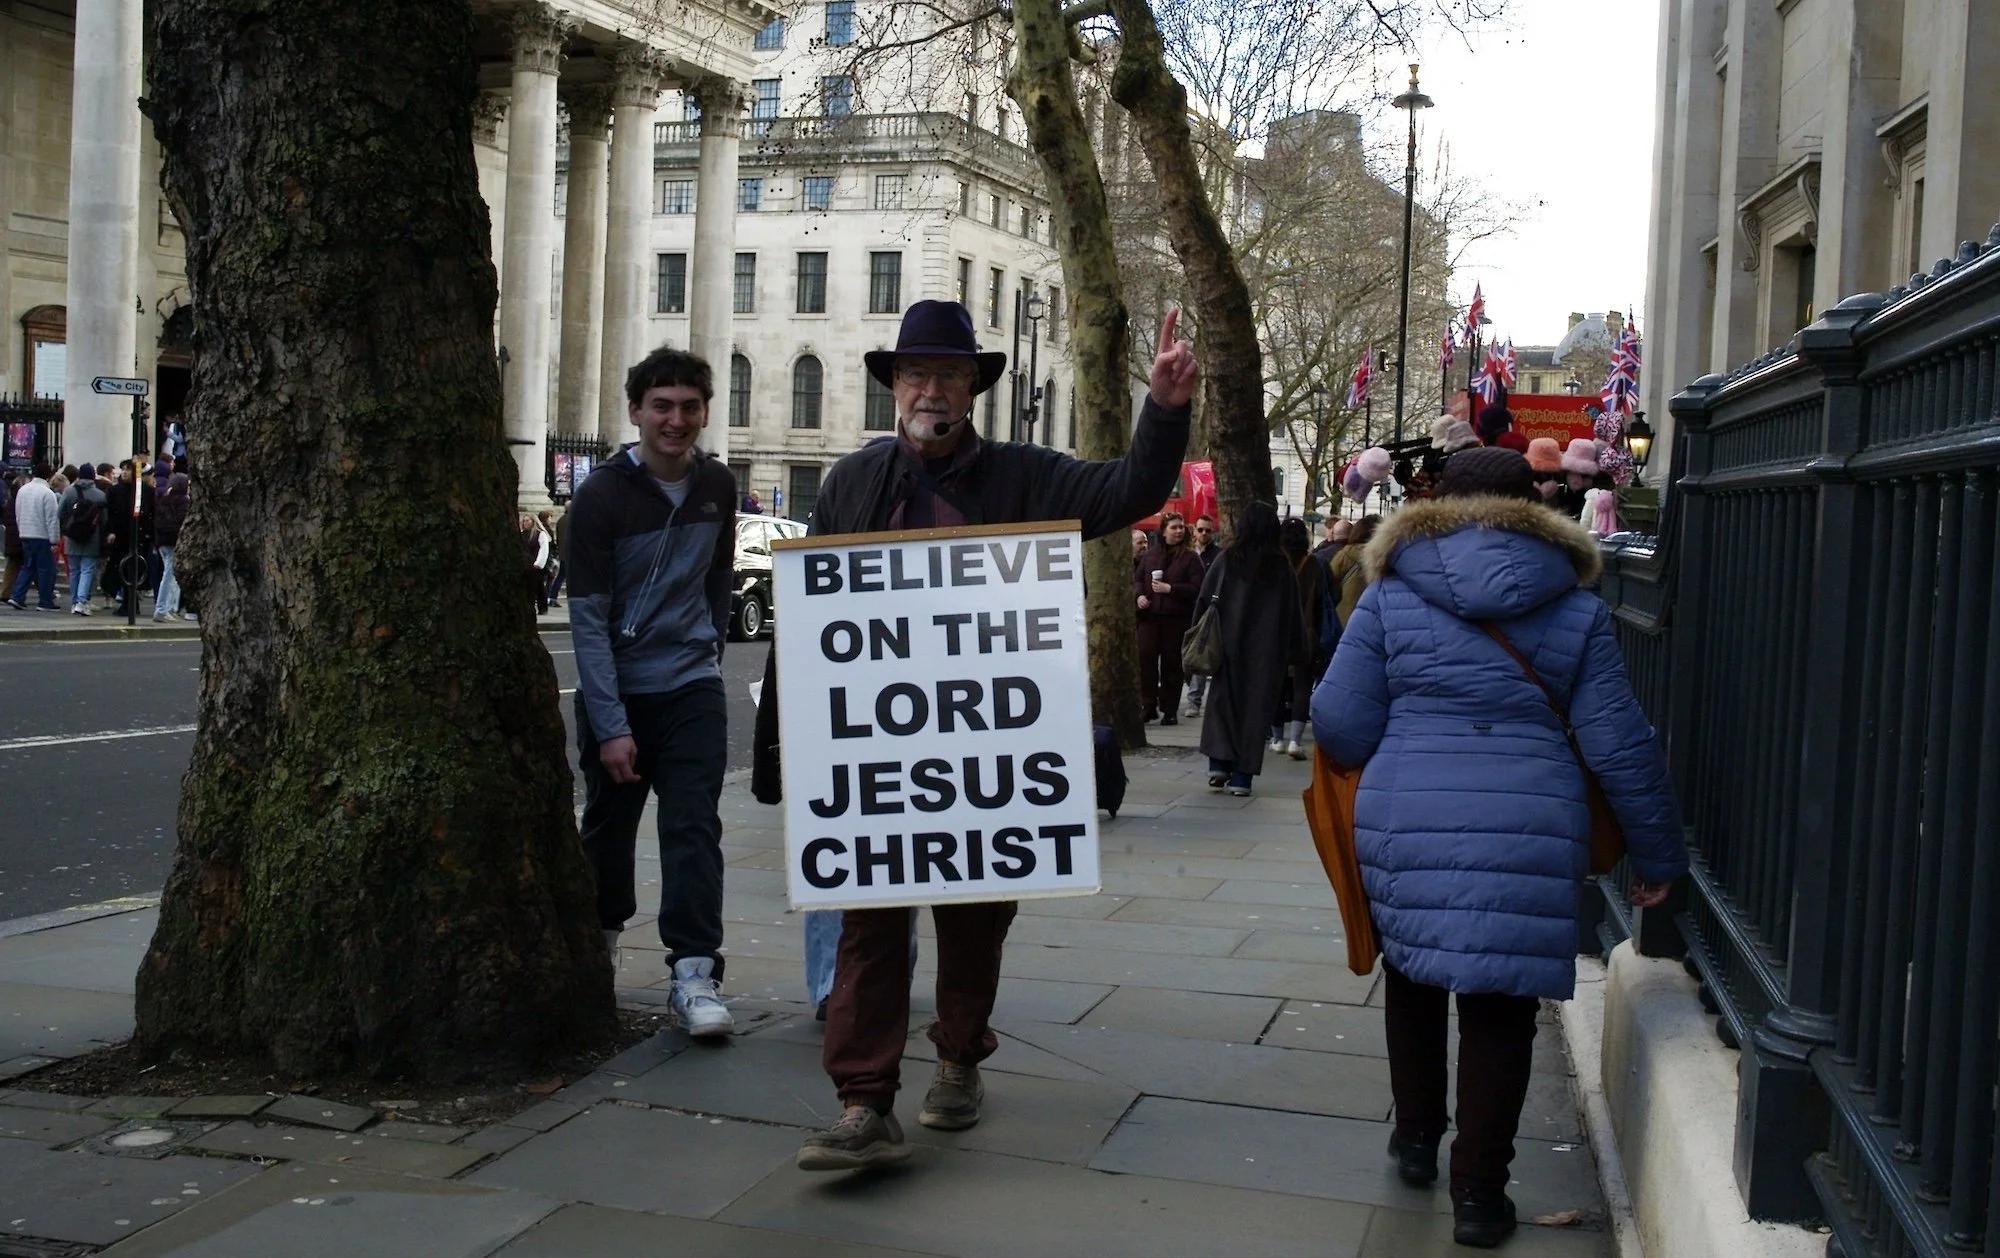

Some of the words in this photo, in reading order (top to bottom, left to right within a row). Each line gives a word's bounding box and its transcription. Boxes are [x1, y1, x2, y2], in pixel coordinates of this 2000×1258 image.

[125, 382, 144, 392] City
[804, 539, 1073, 596] BELIEVE
[820, 616, 911, 663] ON
[933, 608, 1063, 656] THE
[829, 676, 1042, 740] LORD
[808, 752, 1070, 818] JESUS
[801, 824, 1086, 889] CHRIST
